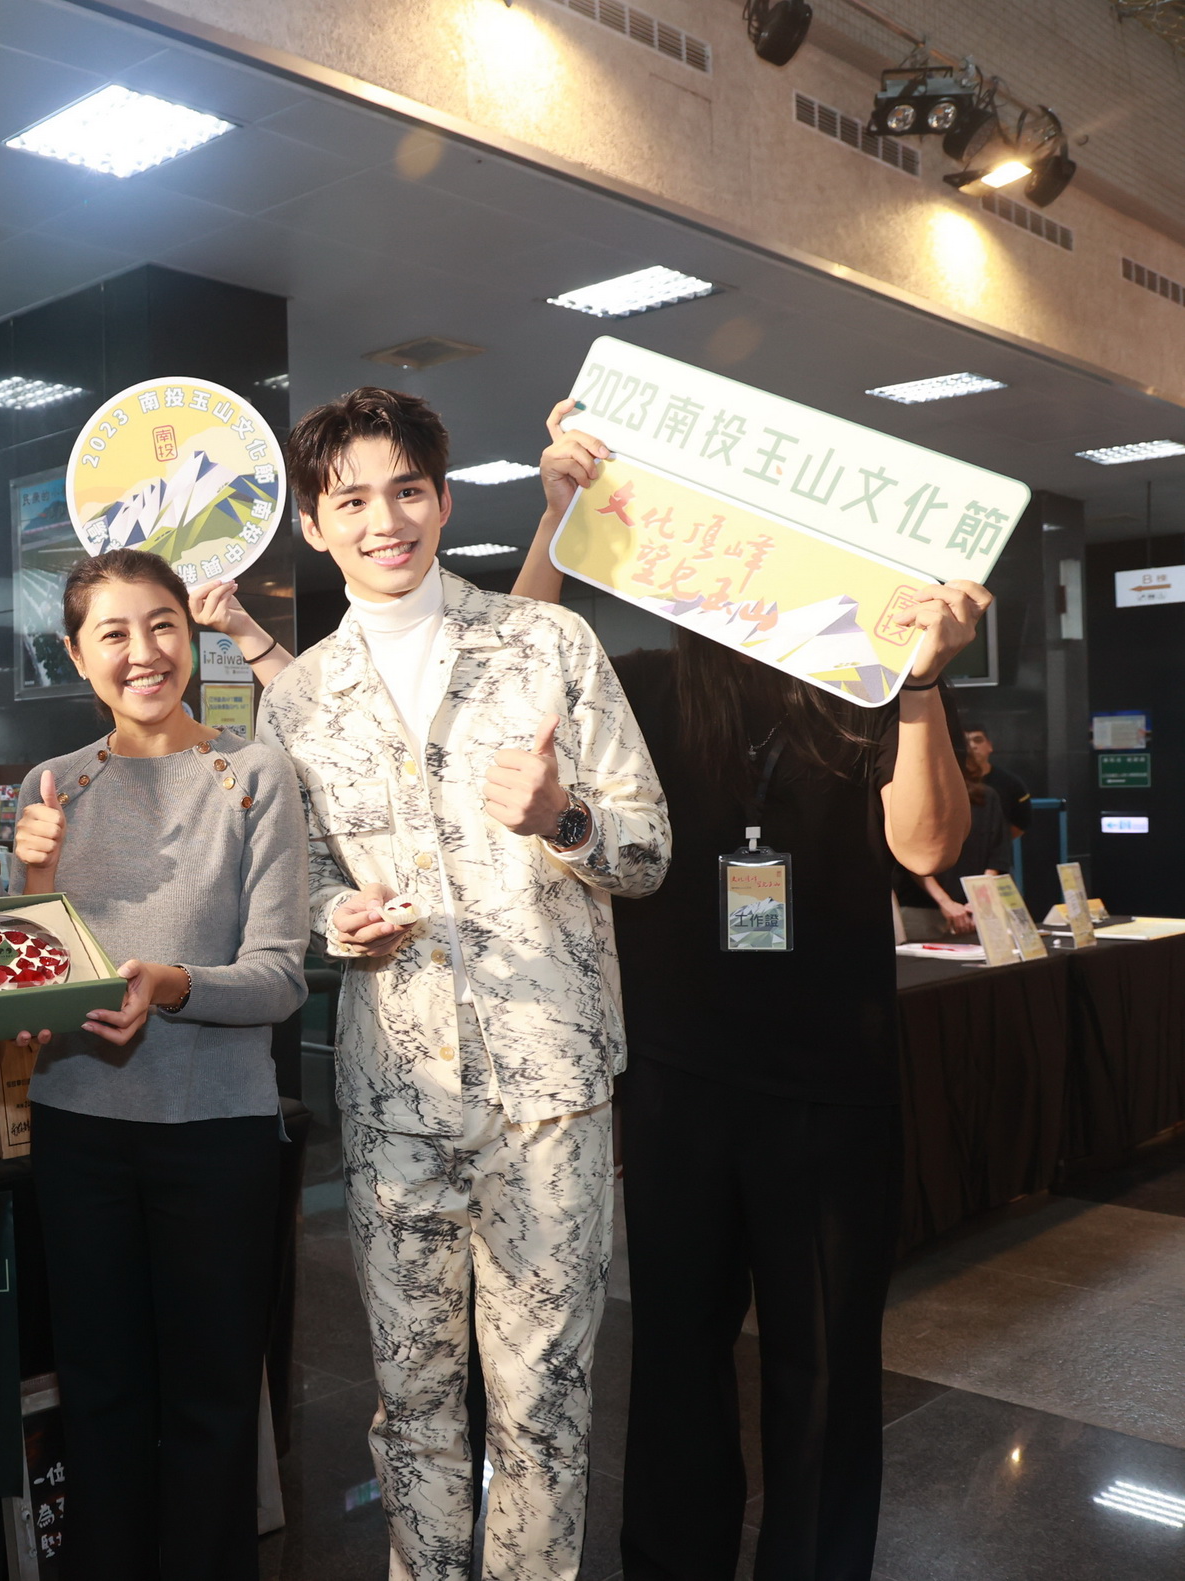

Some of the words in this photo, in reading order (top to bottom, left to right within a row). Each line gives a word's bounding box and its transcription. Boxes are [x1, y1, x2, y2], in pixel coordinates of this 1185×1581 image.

[82, 409, 129, 468] 2023
[138, 387, 275, 484] 南投玉山文化節
[734, 912, 779, 928] 工作證
